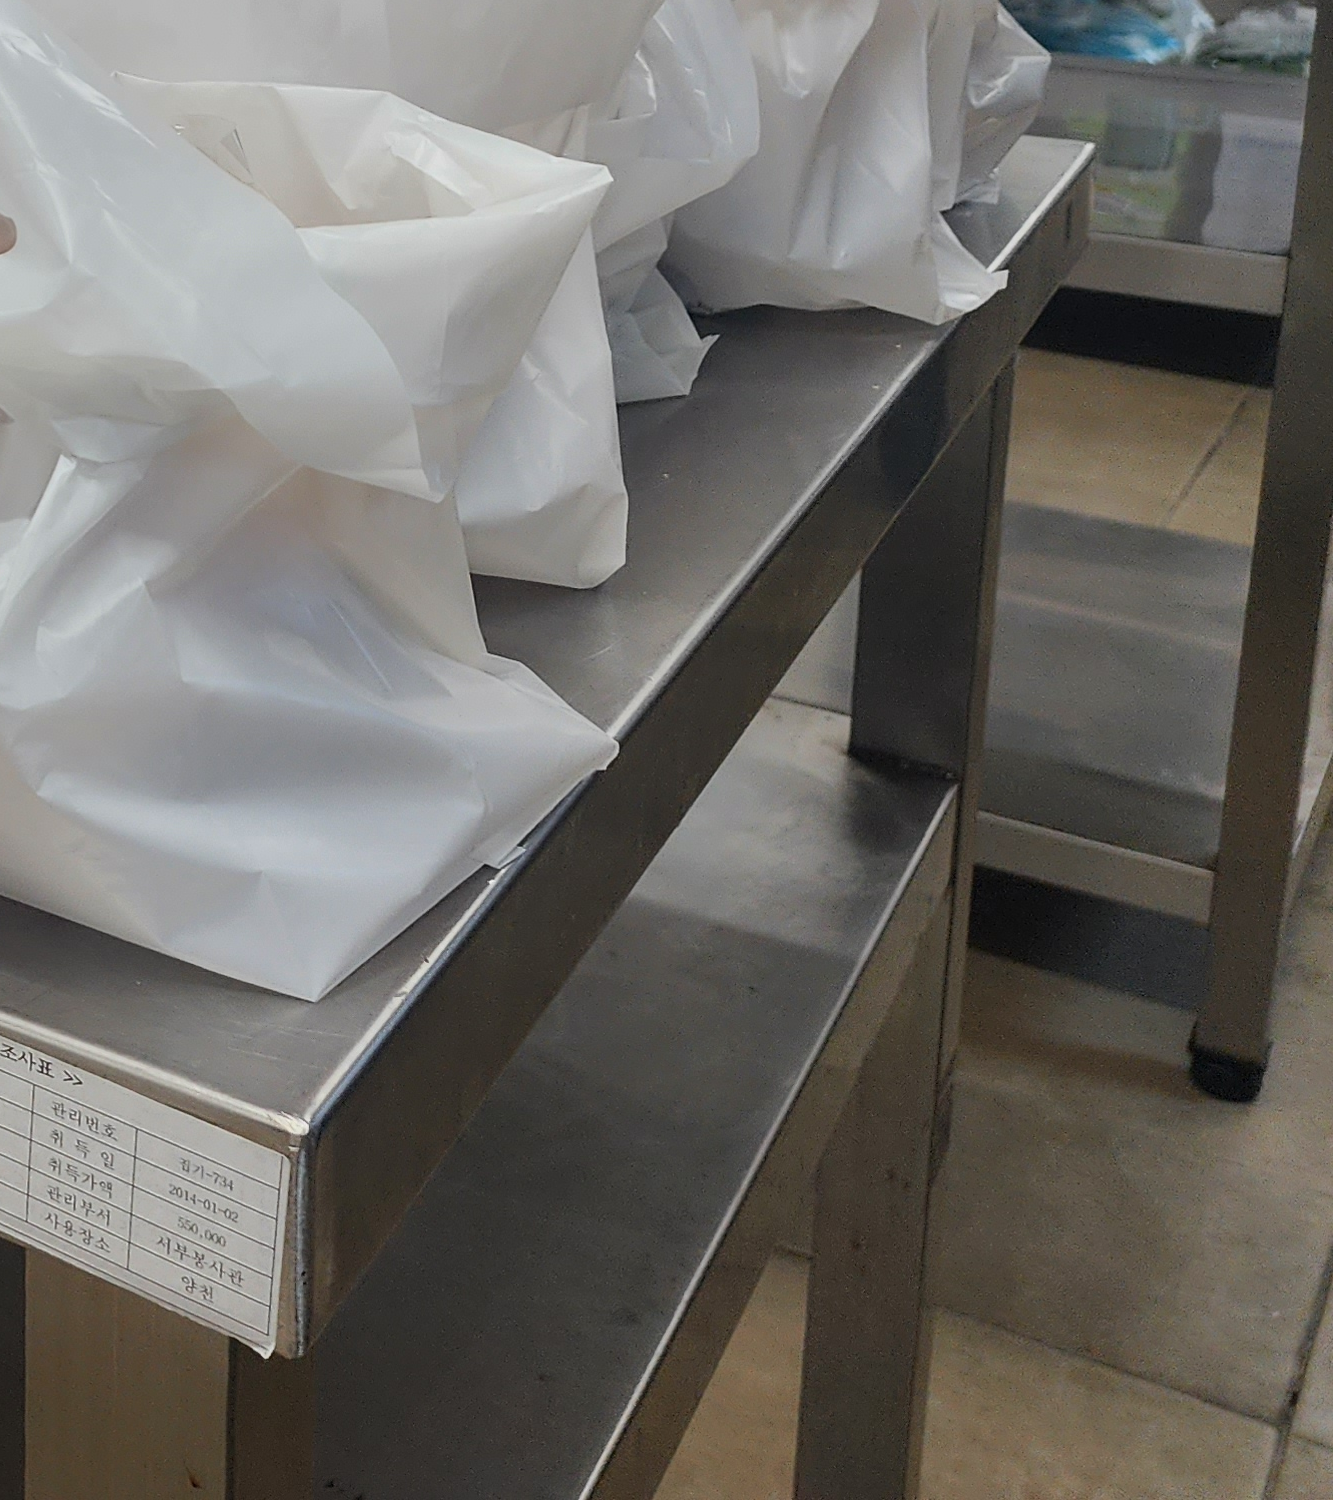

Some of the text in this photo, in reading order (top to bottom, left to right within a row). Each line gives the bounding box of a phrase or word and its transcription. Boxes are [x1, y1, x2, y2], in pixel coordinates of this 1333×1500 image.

[51, 1101, 119, 1142] 관리번호
[46, 1184, 112, 1227] 관리부서
[168, 1183, 240, 1224] 2014-01-02
[44, 1212, 112, 1254] 사용장소
[156, 1235, 245, 1289] 서부봉사관
